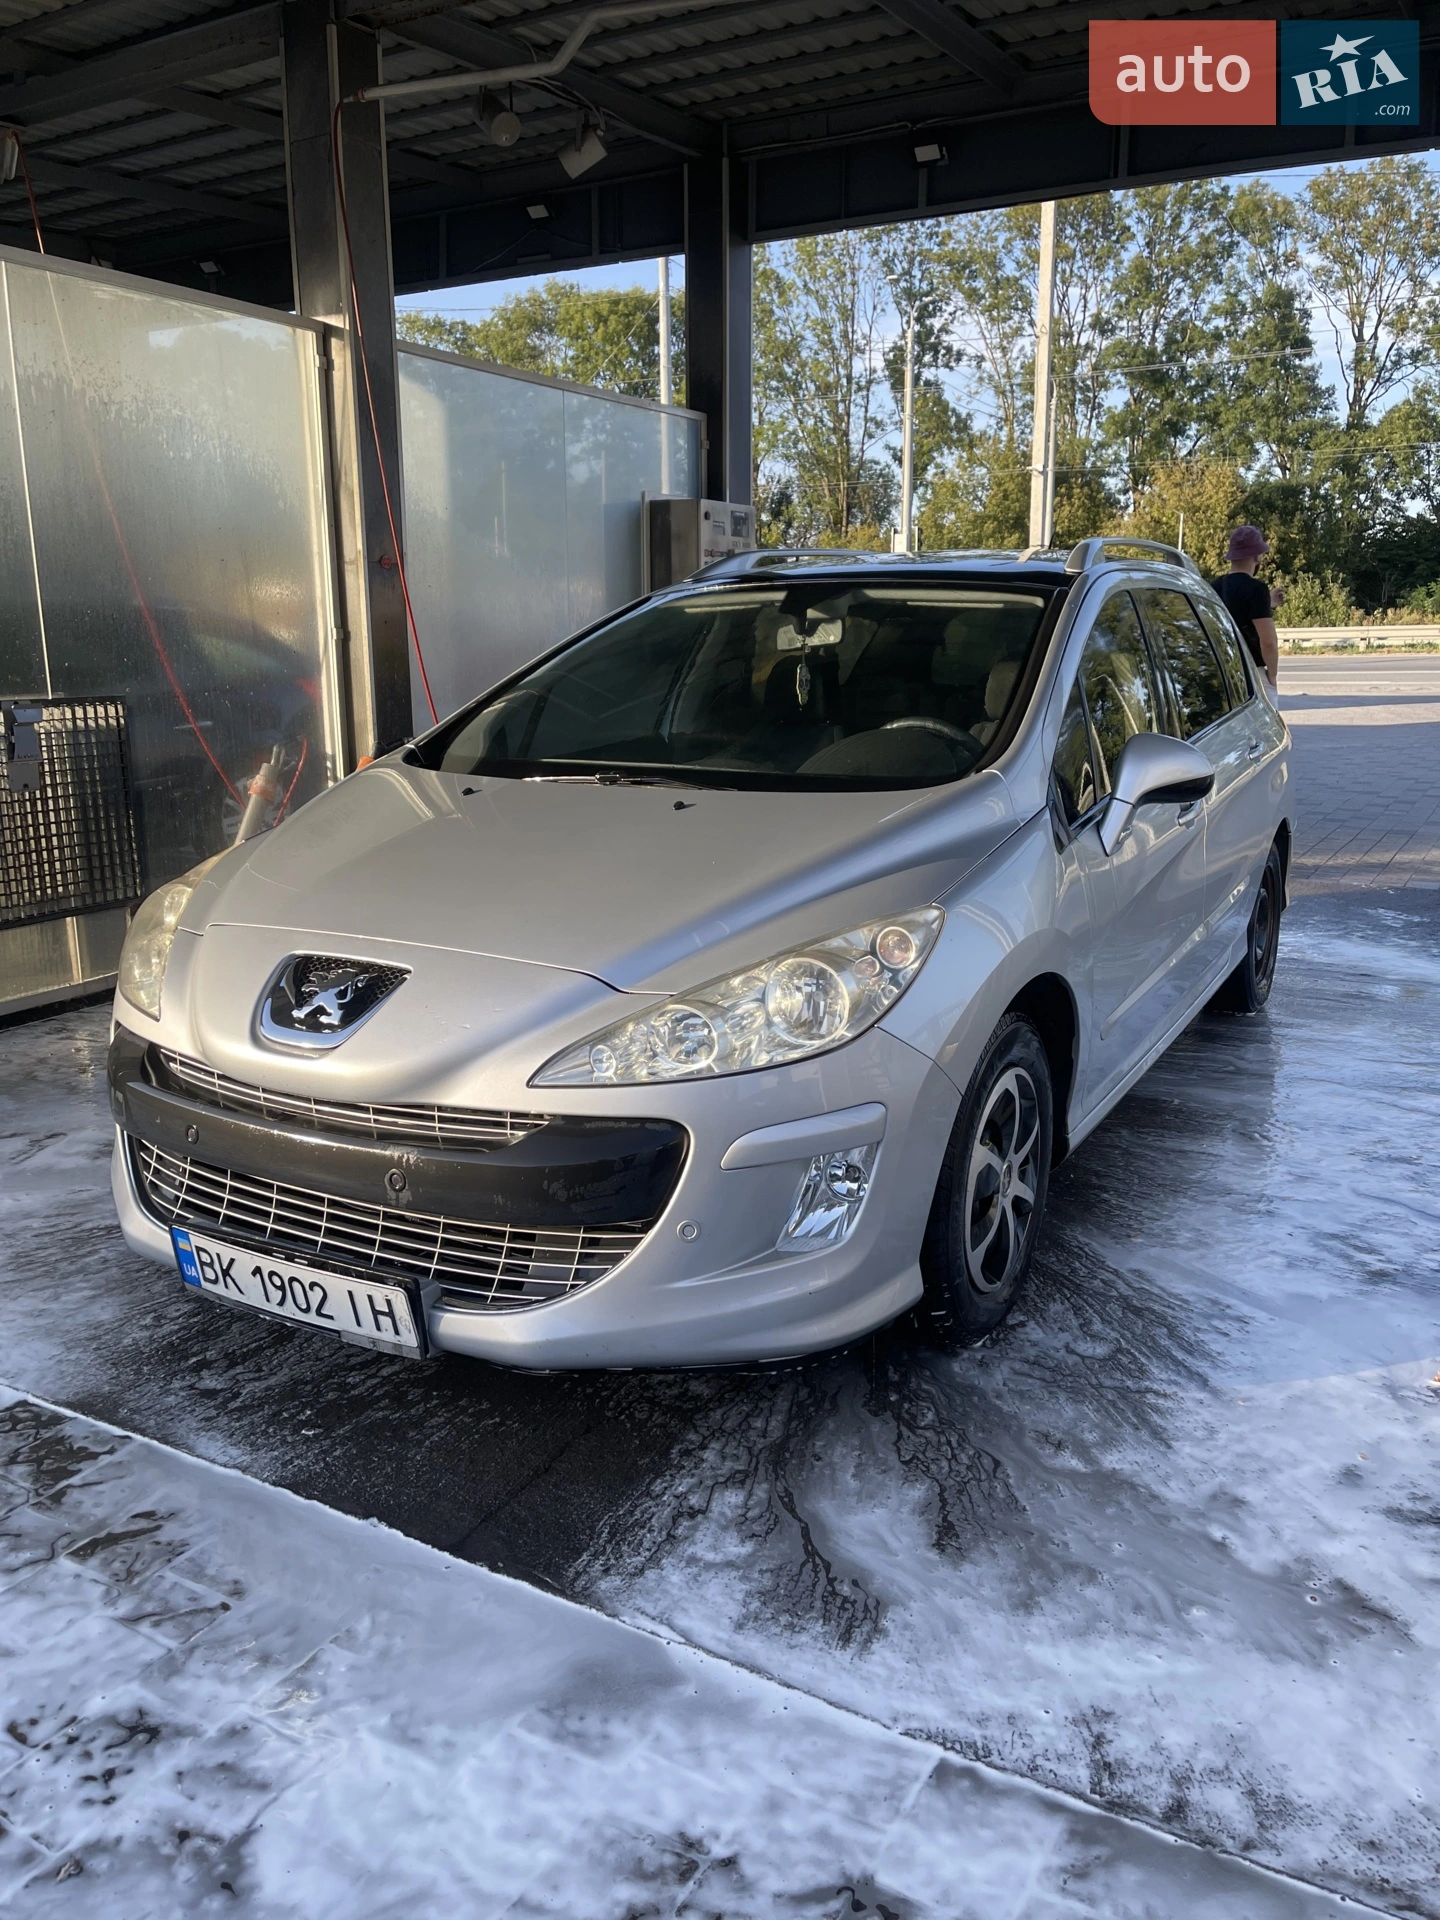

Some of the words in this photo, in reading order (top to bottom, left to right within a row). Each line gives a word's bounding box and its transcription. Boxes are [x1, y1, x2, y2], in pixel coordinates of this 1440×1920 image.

[183, 1263, 199, 1279] UA
[194, 1244, 245, 1296] BK
[250, 1265, 335, 1321] 1902
[346, 1289, 401, 1336] IH
